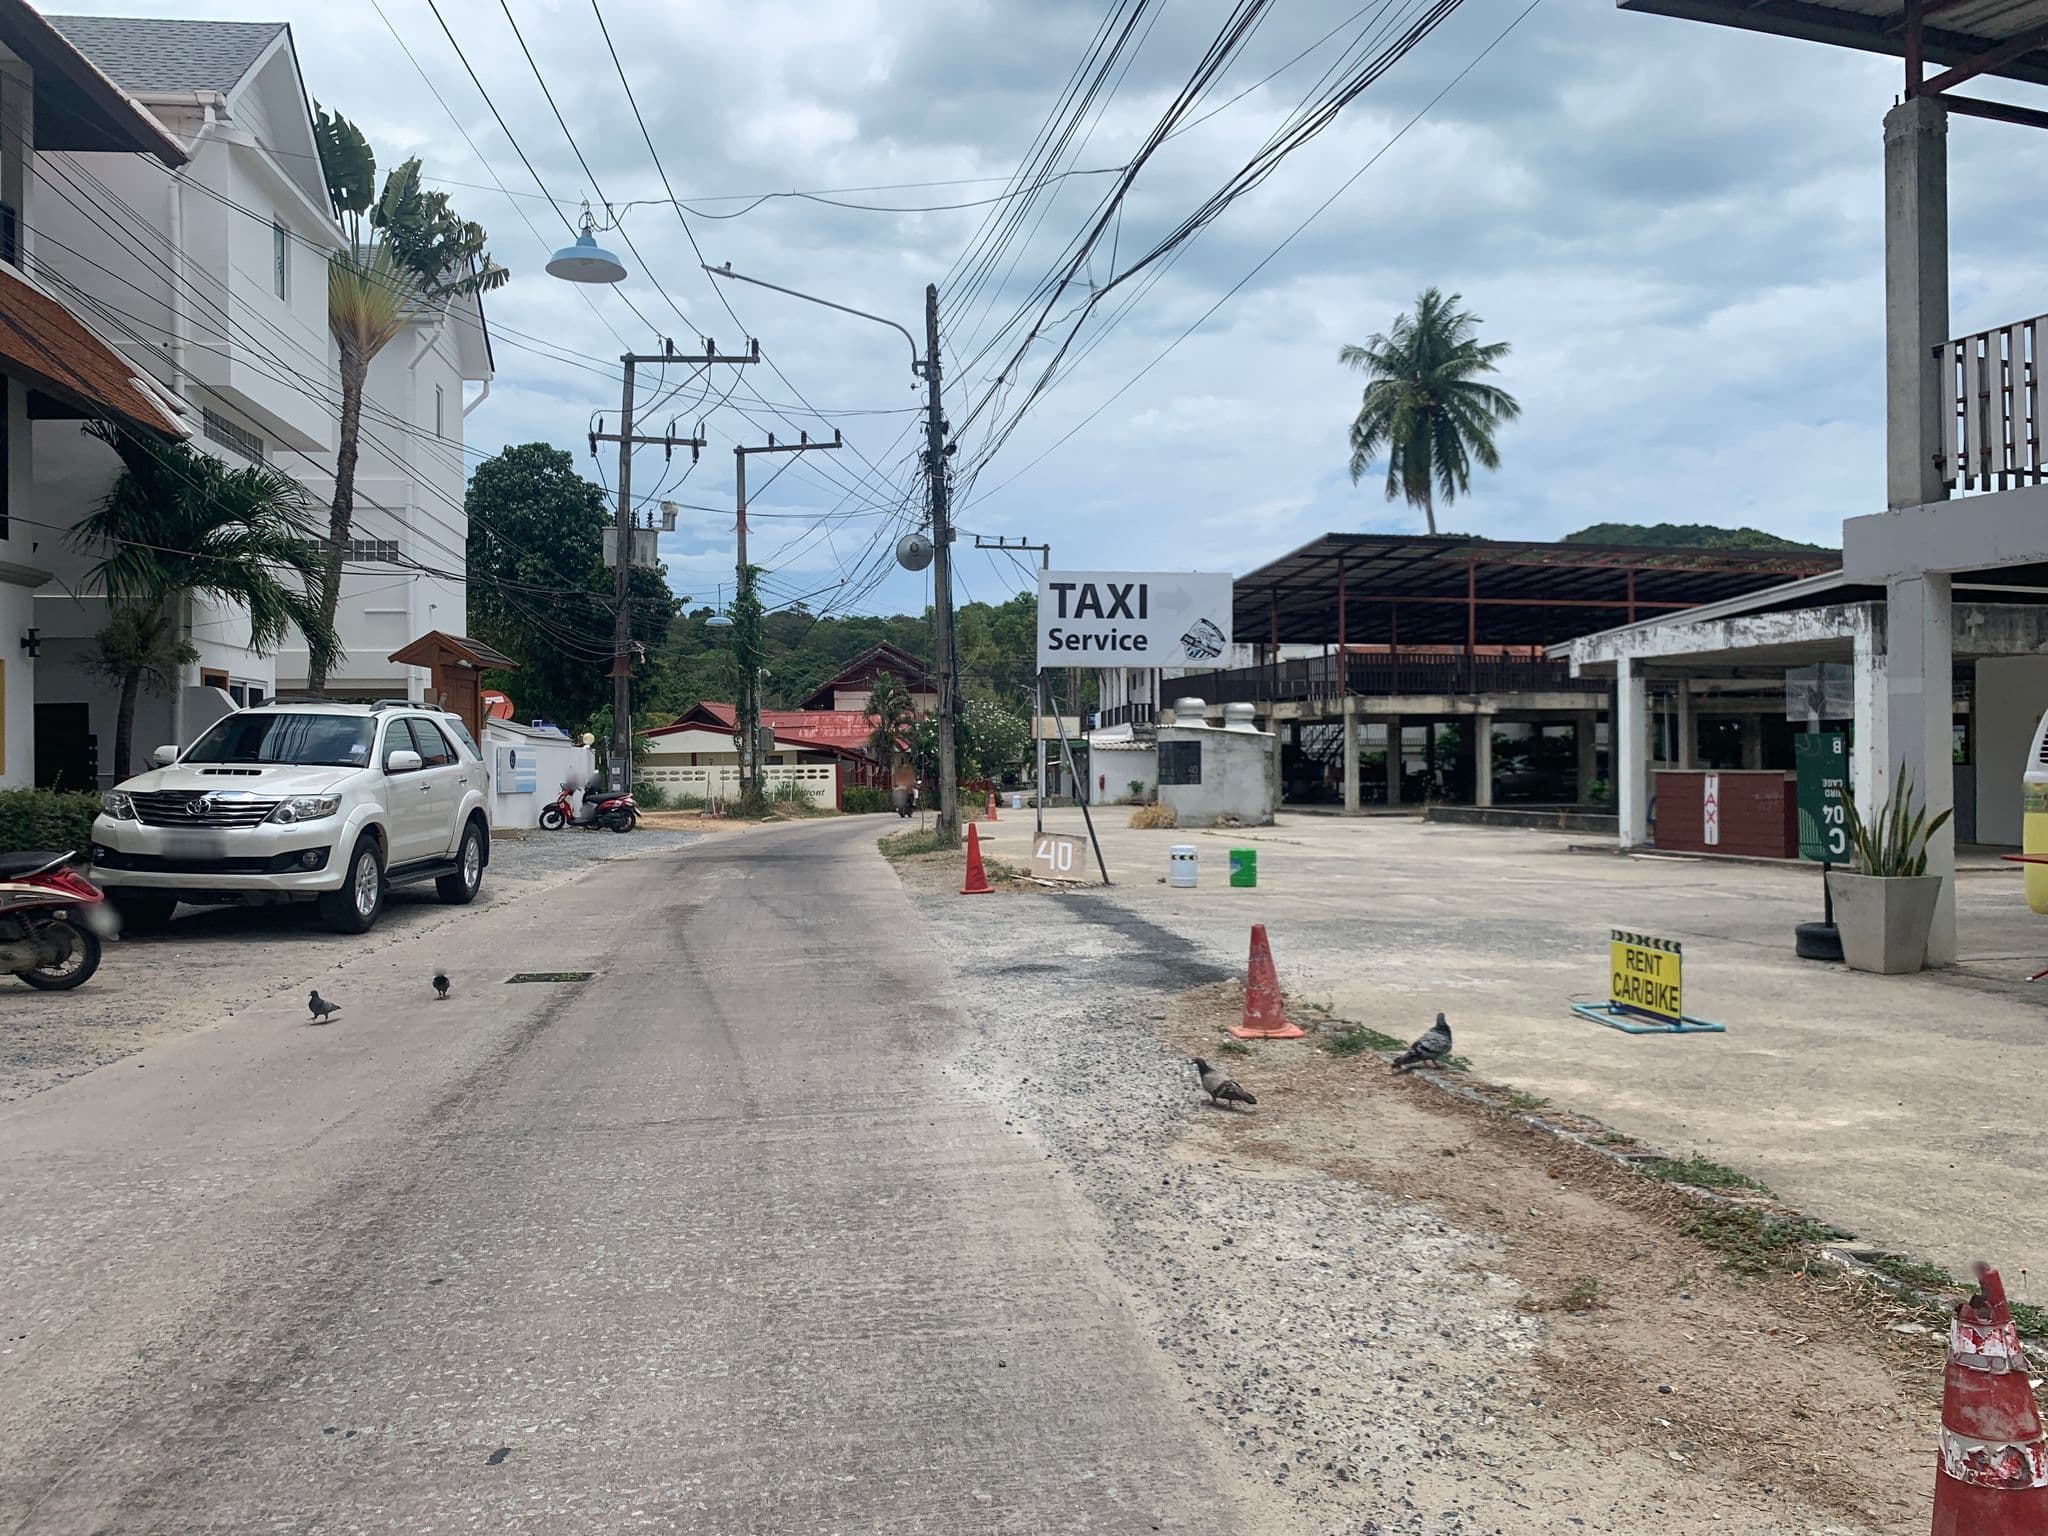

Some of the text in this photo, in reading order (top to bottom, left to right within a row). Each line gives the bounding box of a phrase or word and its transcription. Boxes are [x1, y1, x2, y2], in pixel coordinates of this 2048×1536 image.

[1049, 583, 1148, 619] TAXI
[1048, 628, 1148, 651] Service
[1704, 774, 1717, 843] TAXI
[1822, 805, 1844, 824] 04
[1036, 841, 1073, 870] 40
[1626, 949, 1663, 976] RENT
[1613, 972, 1679, 1012] CAR/BIKE
